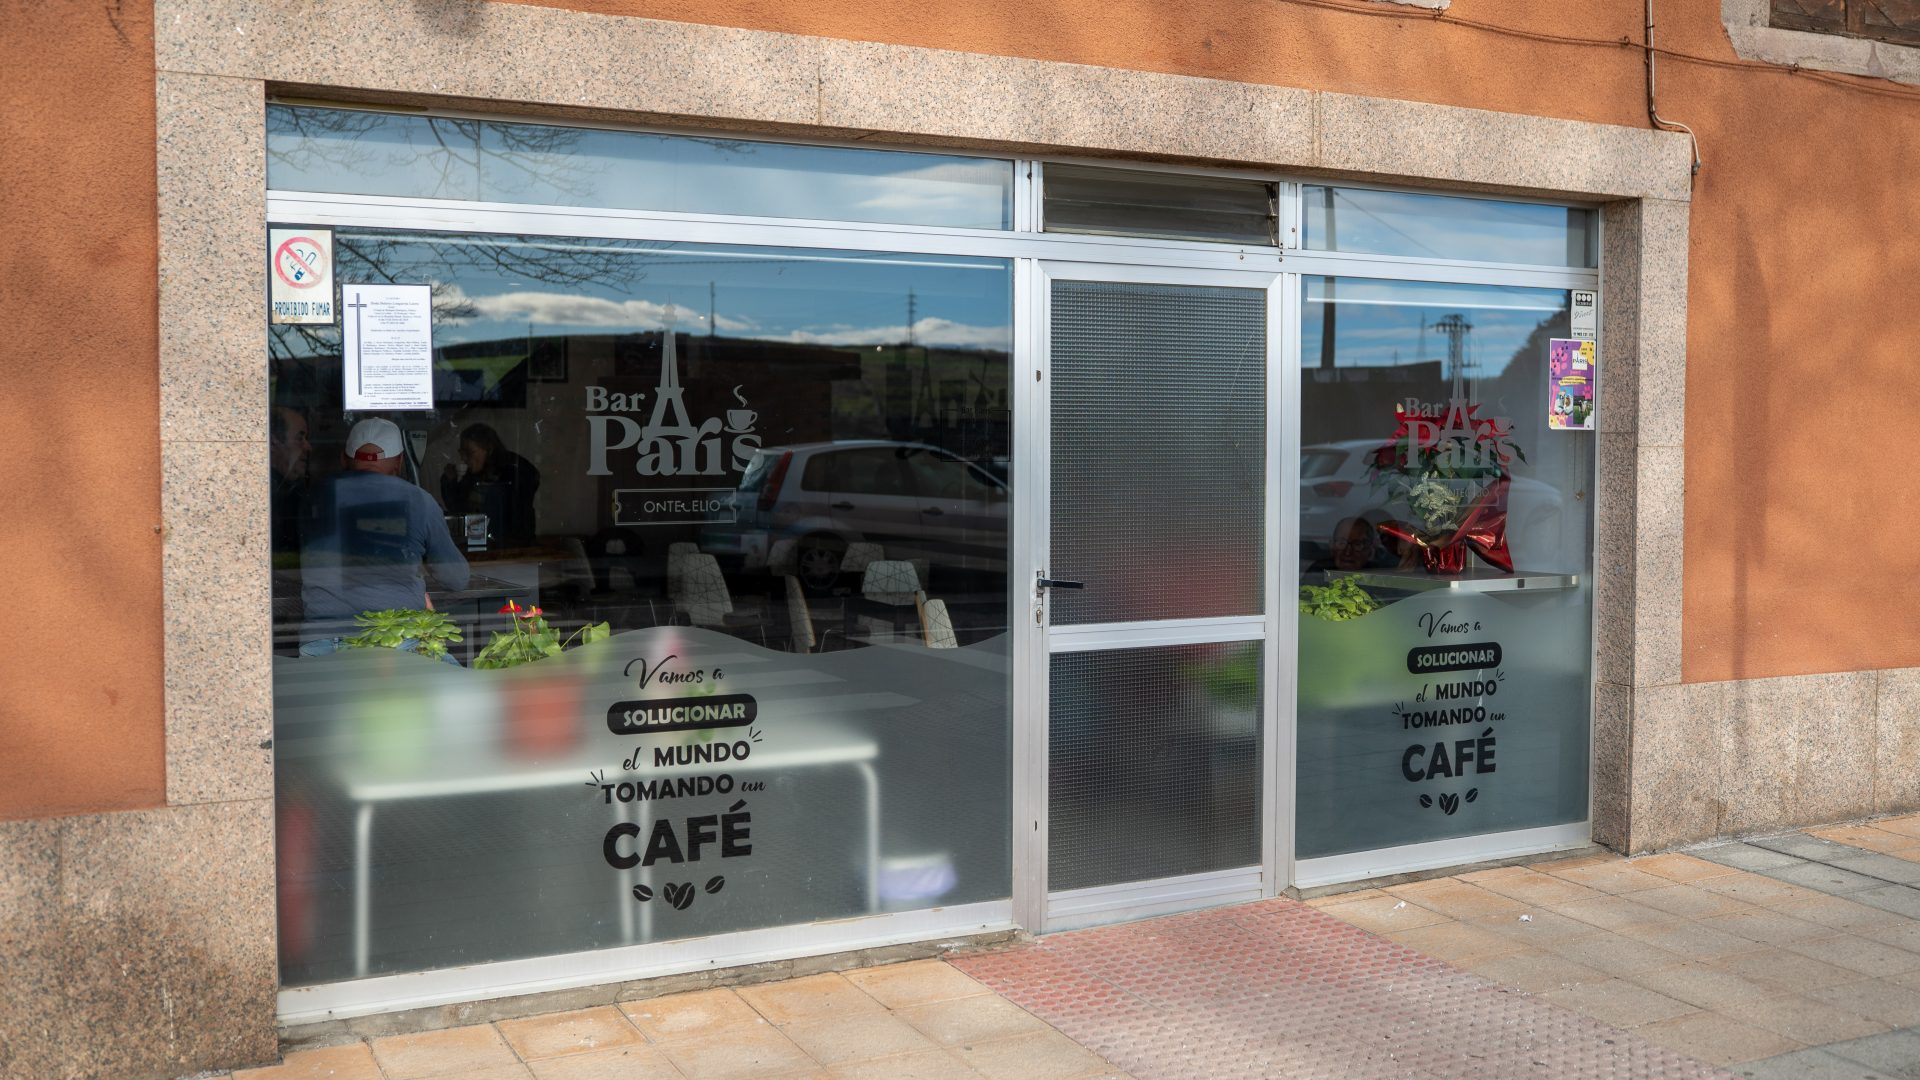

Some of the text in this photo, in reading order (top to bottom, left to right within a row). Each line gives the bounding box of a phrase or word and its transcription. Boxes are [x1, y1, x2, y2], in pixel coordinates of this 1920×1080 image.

[275, 301, 330, 316] PROHIBIDO FUMAR
[585, 385, 646, 412] Bar
[1404, 397, 1443, 418] Bar
[585, 415, 765, 476] Paris
[1403, 420, 1517, 469] Paris
[1418, 610, 1482, 638] Vamos a
[623, 654, 725, 690] Vamos a
[1417, 649, 1495, 668] SOLUCIONAR
[1416, 680, 1497, 703] el MUNDO
[623, 703, 746, 727] SOLUCIONAR
[1402, 707, 1506, 730] TOMANDO un
[622, 740, 751, 770] el MUNDO
[1401, 726, 1497, 783] CAFÉ
[601, 773, 766, 804] TOMANDO un
[602, 798, 753, 870] CAFÉ
